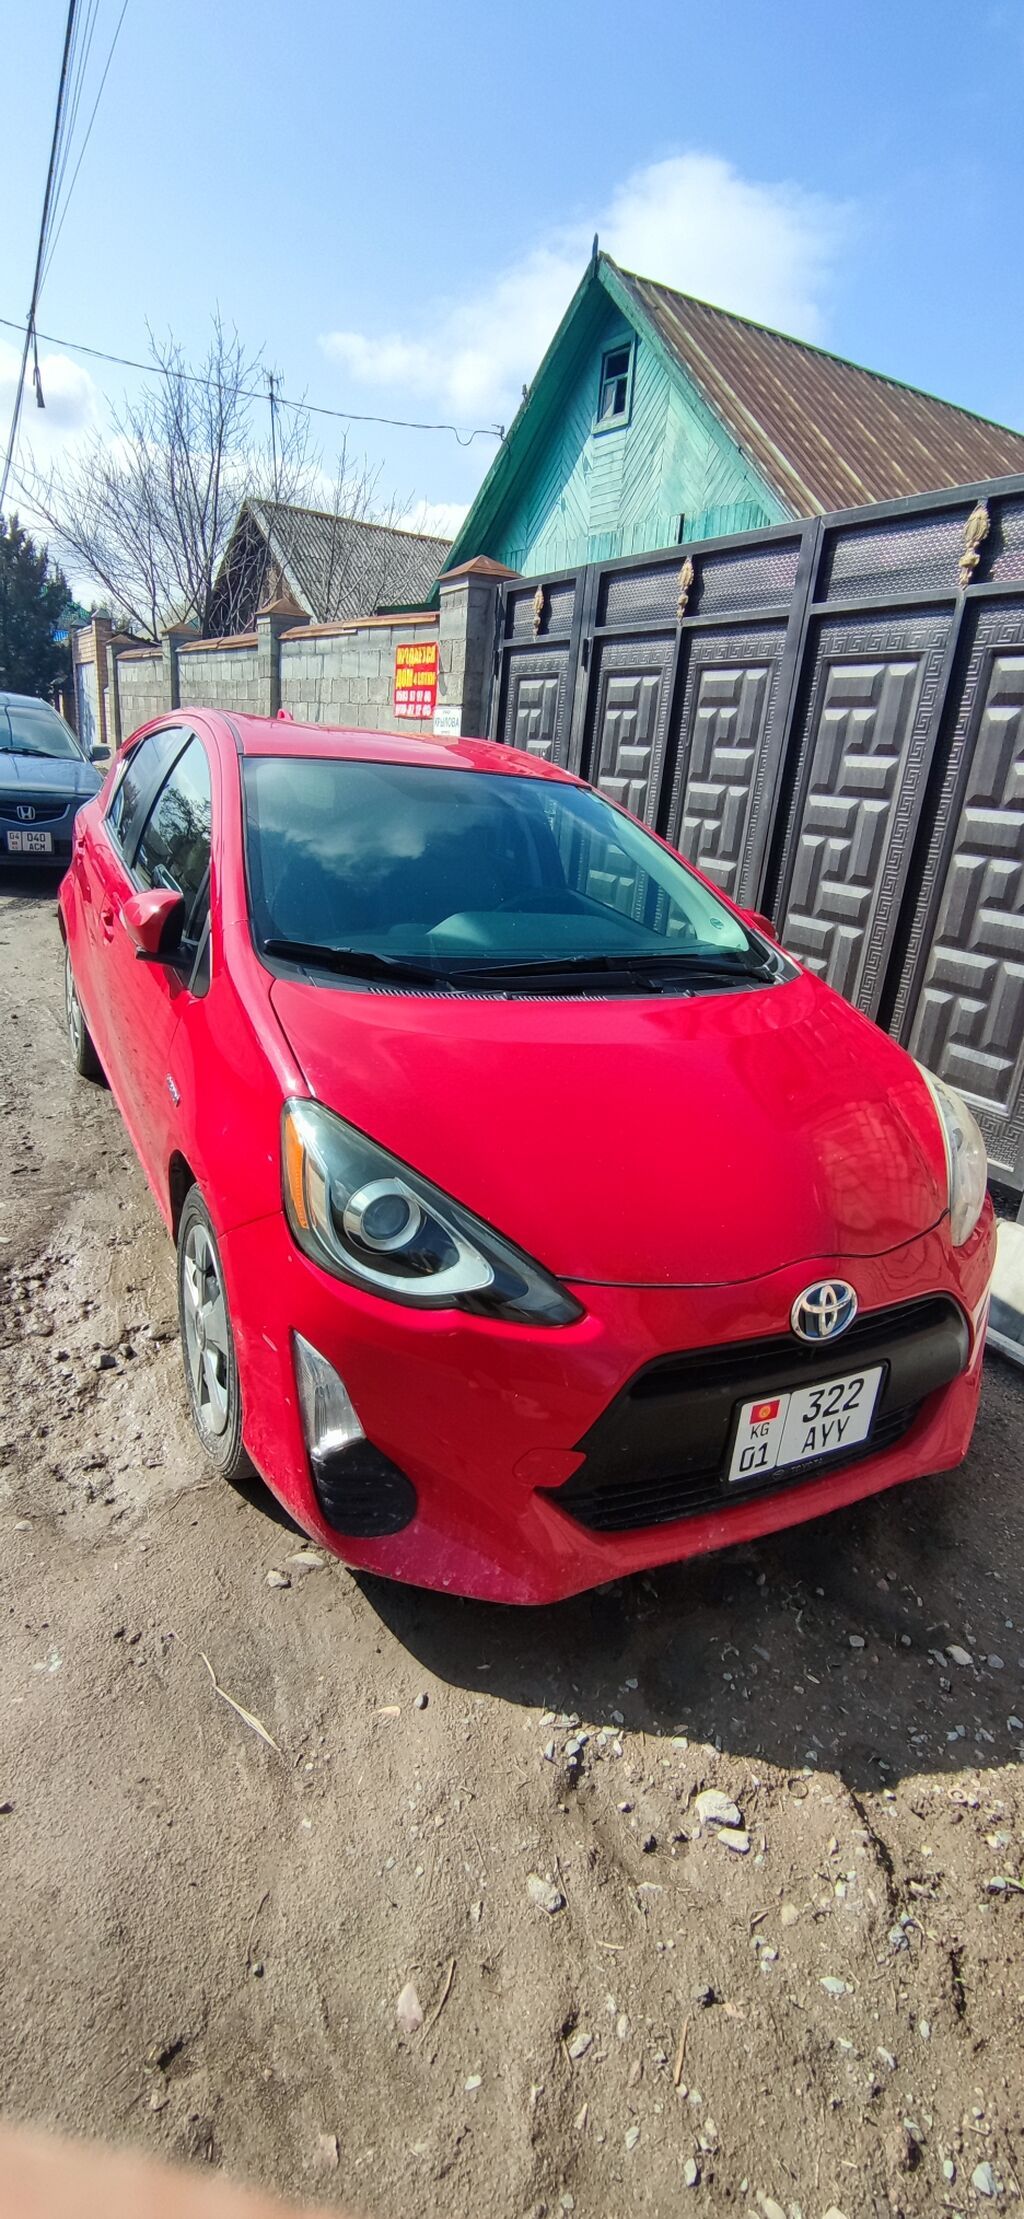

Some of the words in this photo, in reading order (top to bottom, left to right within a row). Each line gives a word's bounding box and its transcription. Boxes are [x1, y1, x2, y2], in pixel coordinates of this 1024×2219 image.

[397, 646, 435, 667] ПРОДАЕТСЯ
[396, 668, 414, 689] ДОМ
[27, 832, 46, 842] 040
[29, 843, 46, 851] ACM
[802, 1378, 865, 1423] 322
[750, 1422, 770, 1440] KG
[801, 1415, 850, 1454] AYY
[739, 1441, 769, 1472] 01
